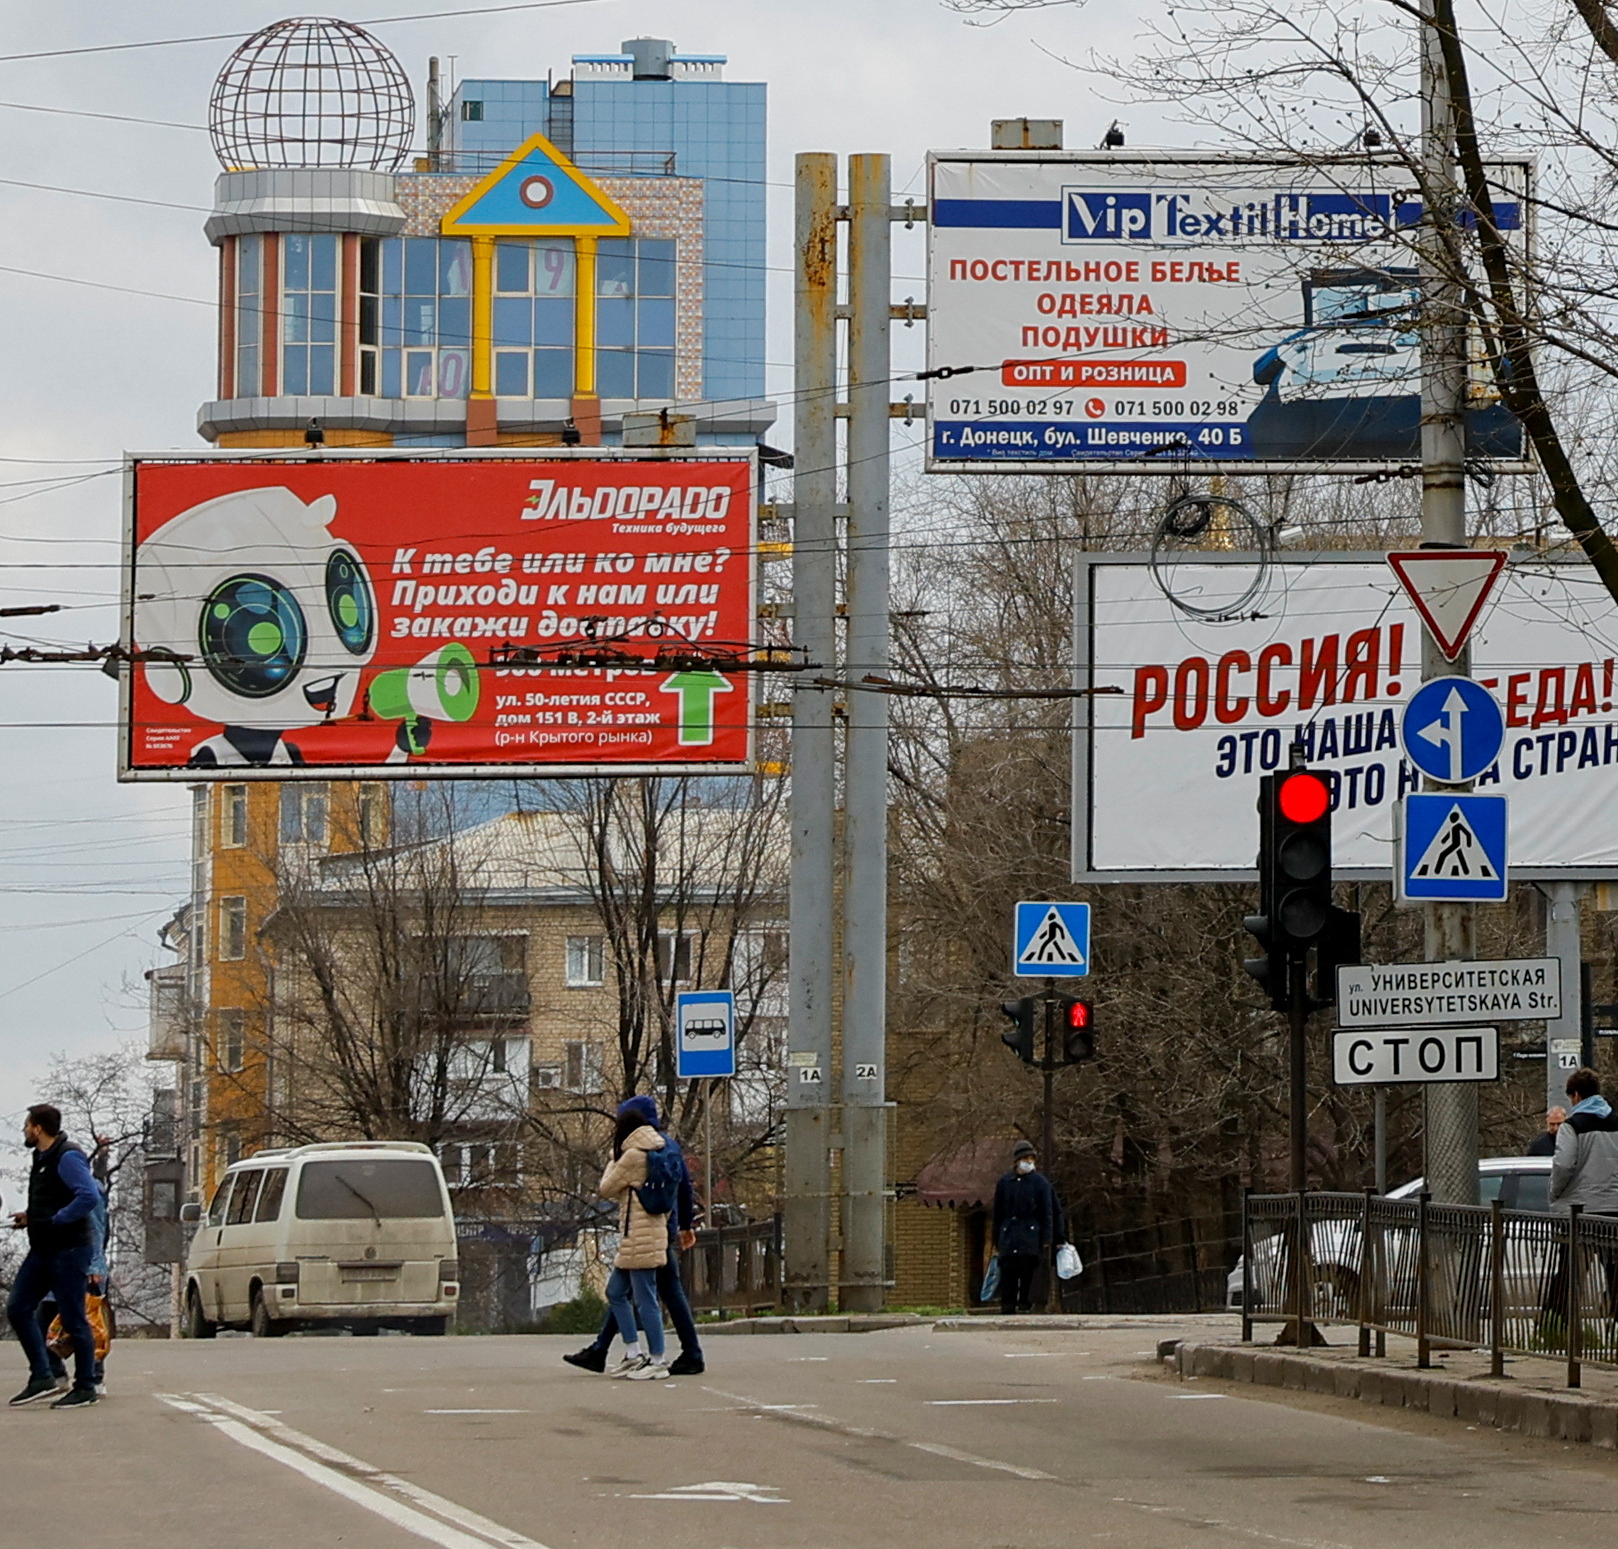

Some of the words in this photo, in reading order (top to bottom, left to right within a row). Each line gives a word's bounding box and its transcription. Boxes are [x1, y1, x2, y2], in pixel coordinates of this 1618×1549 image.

[1070, 193, 1146, 239] Vip
[1155, 195, 1268, 237] Textil
[1279, 194, 1388, 239] Home
[950, 259, 1140, 282] ПОСТЕЛЬНОЕ
[1151, 261, 1240, 283] БЕЛЬЕ
[1036, 293, 1154, 319] ОДЕЯЛА
[1022, 326, 1169, 352] ПОДУШКИ
[1013, 366, 1054, 381] ОПТ
[1060, 366, 1074, 381] И
[1081, 366, 1175, 383] РОЗНИЦА
[950, 399, 985, 415] 071
[987, 399, 1021, 415] 500
[1026, 400, 1048, 415] 02
[1052, 400, 1074, 415] 97
[1115, 400, 1149, 416] 071
[1152, 400, 1183, 416] 500
[1189, 400, 1212, 416] 02
[1216, 400, 1238, 416] 98
[941, 431, 955, 445] г.
[960, 427, 1038, 448] Донецк,
[1044, 427, 1081, 448] бул.
[1198, 428, 1225, 445] 40
[1229, 428, 1242, 445] Б
[612, 523, 662, 533] Техника
[665, 523, 726, 535] будущего
[391, 548, 416, 574] К
[422, 548, 513, 574] тебе
[522, 553, 586, 574] или
[594, 553, 635, 574] ко
[643, 547, 731, 574] мне?
[391, 580, 540, 612] Приходи
[547, 585, 570, 605] к
[576, 584, 646, 605] нам
[655, 584, 719, 605] или
[390, 617, 529, 638] закажи
[537, 610, 718, 641] доставку!
[1131, 622, 1404, 740] РОССИЯ!
[496, 695, 521, 709] ул.
[525, 693, 600, 706] 50-летия
[605, 692, 650, 707] СССР,
[495, 714, 531, 727] дом
[535, 711, 563, 724] 151
[567, 711, 583, 727] В,
[586, 710, 613, 724] 2-й
[616, 713, 661, 724] этаж
[495, 731, 525, 746] (р-н
[529, 731, 595, 746] Крытого
[599, 730, 653, 746] рынка)
[1216, 728, 1281, 779] ЭТО
[1295, 708, 1397, 762] НАША
[1349, 982, 1363, 995] ул.
[1371, 968, 1545, 992] УНИВЕРСИТЕТСКАЯ
[1349, 993, 1521, 1016] UNIVERSYTETSKAYA
[1528, 993, 1558, 1008] Str.
[1348, 1036, 1483, 1075] СТОП
